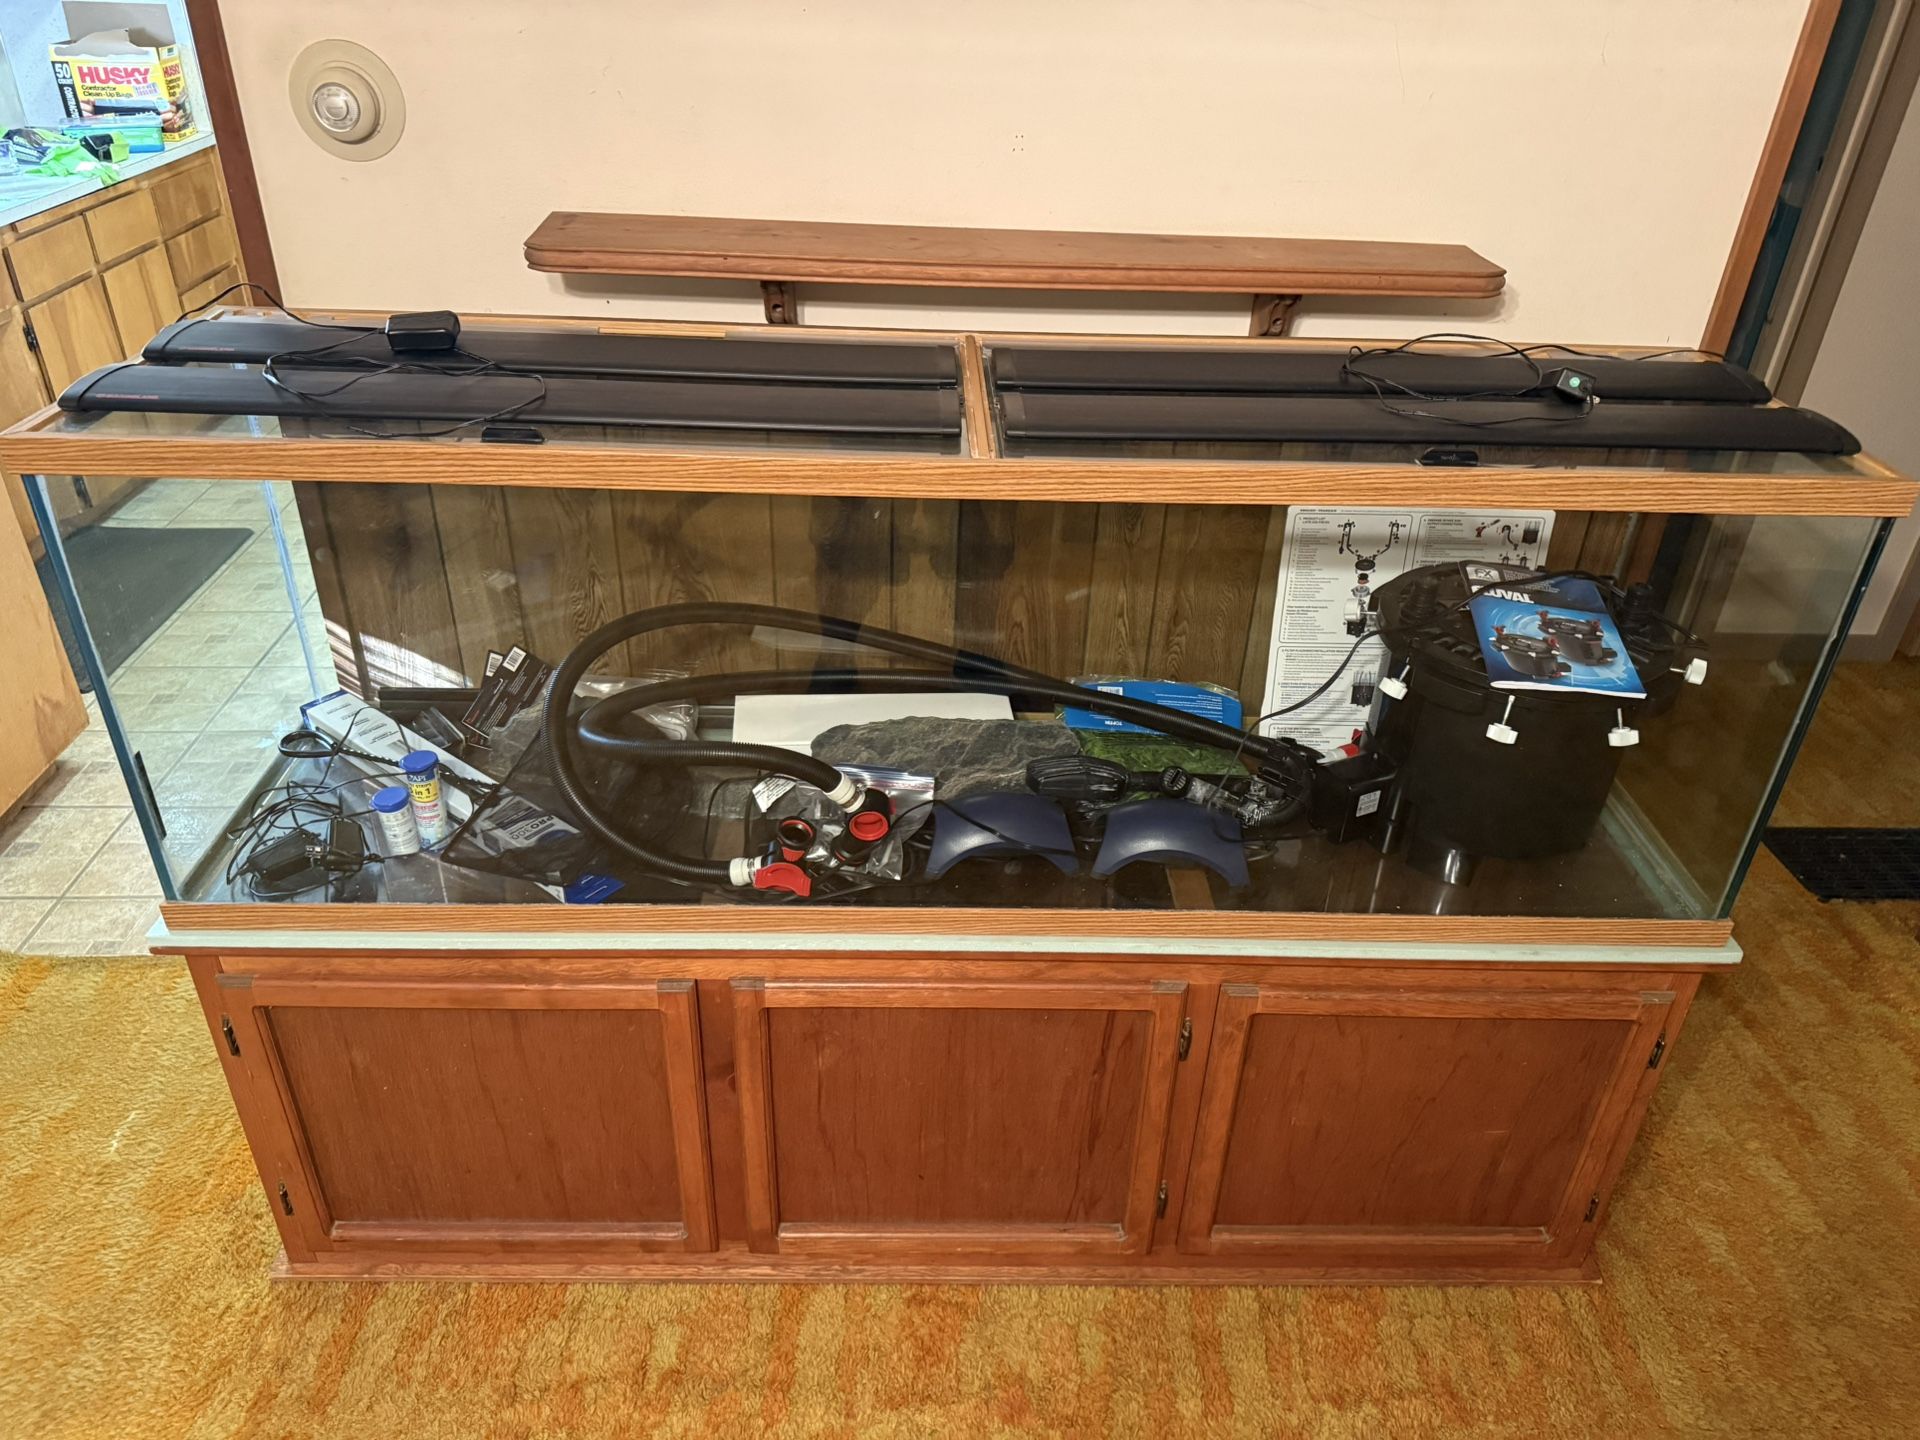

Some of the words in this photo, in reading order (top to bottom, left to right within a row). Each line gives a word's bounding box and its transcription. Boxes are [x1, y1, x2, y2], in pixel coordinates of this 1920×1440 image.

[54, 63, 71, 78] 50
[77, 66, 150, 84] HUSKY
[162, 64, 180, 78] HUSKY
[1475, 568, 1492, 578] FX
